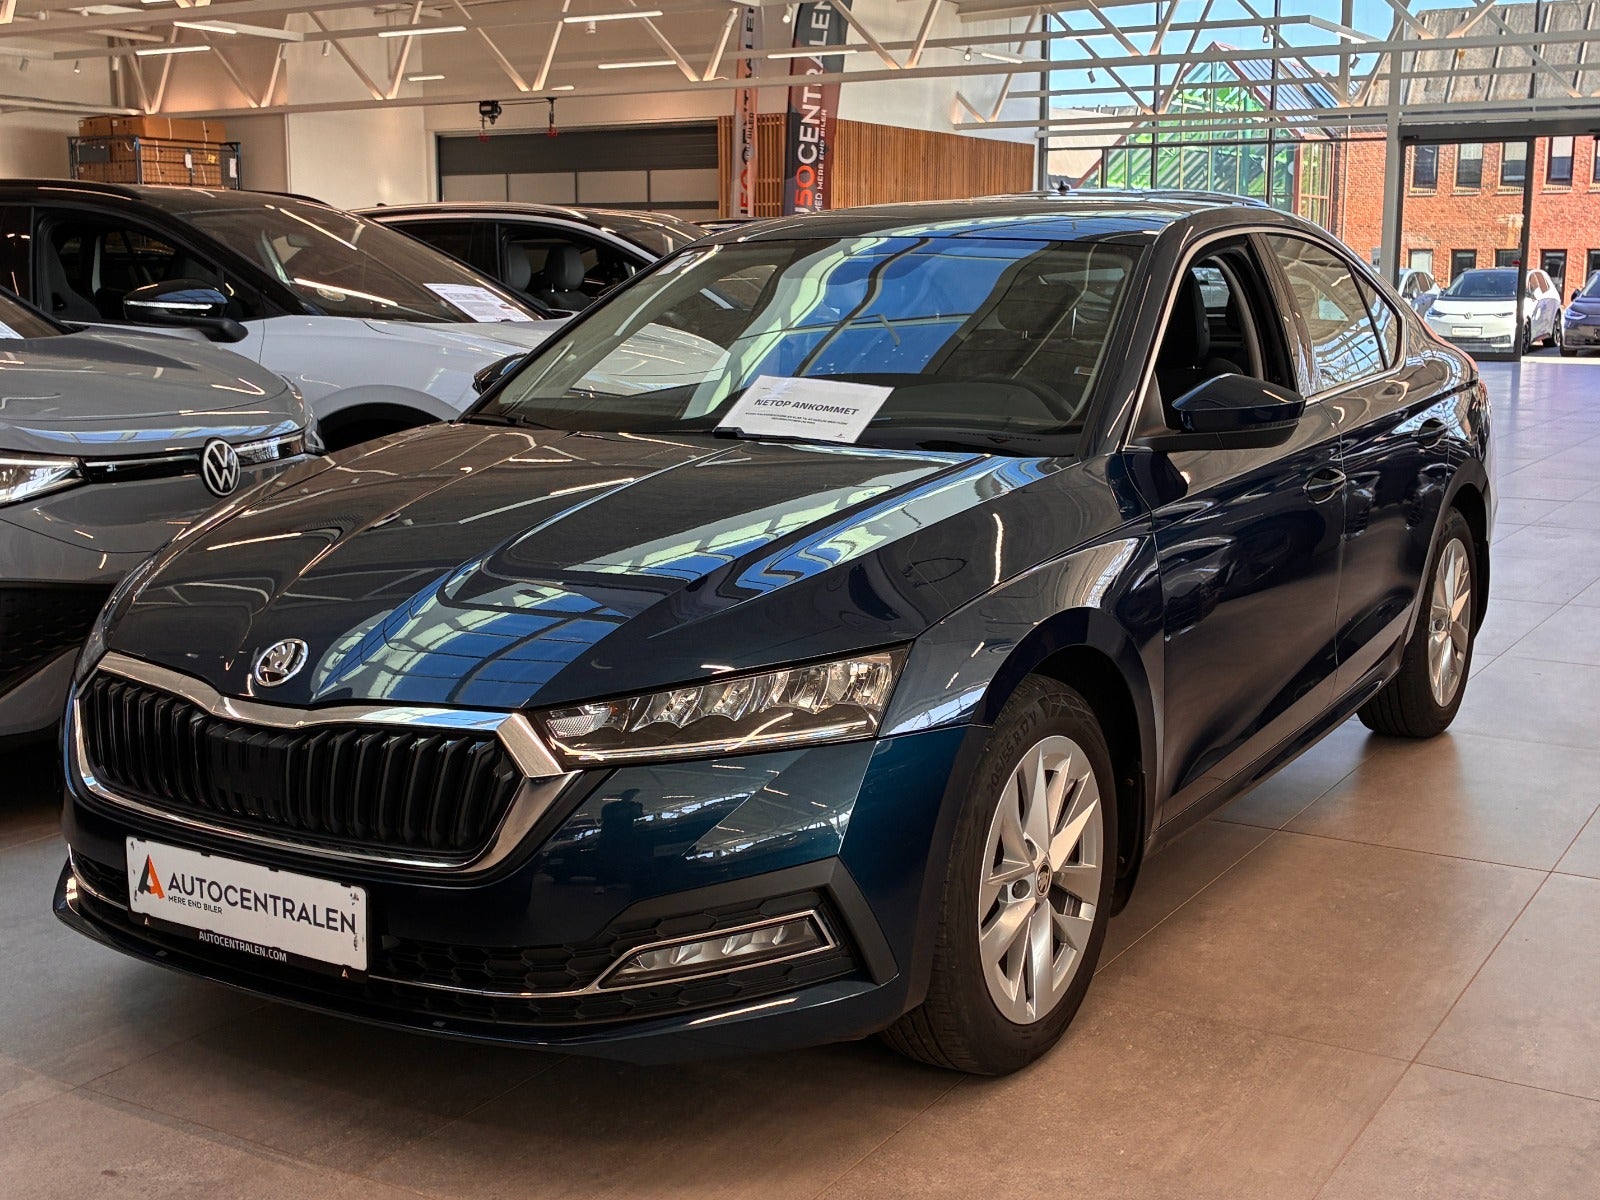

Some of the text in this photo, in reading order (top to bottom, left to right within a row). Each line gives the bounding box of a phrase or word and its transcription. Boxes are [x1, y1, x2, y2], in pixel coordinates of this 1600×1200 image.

[755, 399, 859, 416] NETOP ANKOMMET
[168, 872, 356, 934] AUTOCENTRALEN
[168, 894, 223, 914] MERE END BILER
[198, 930, 287, 963] AUTOCENTRALEN.COM
